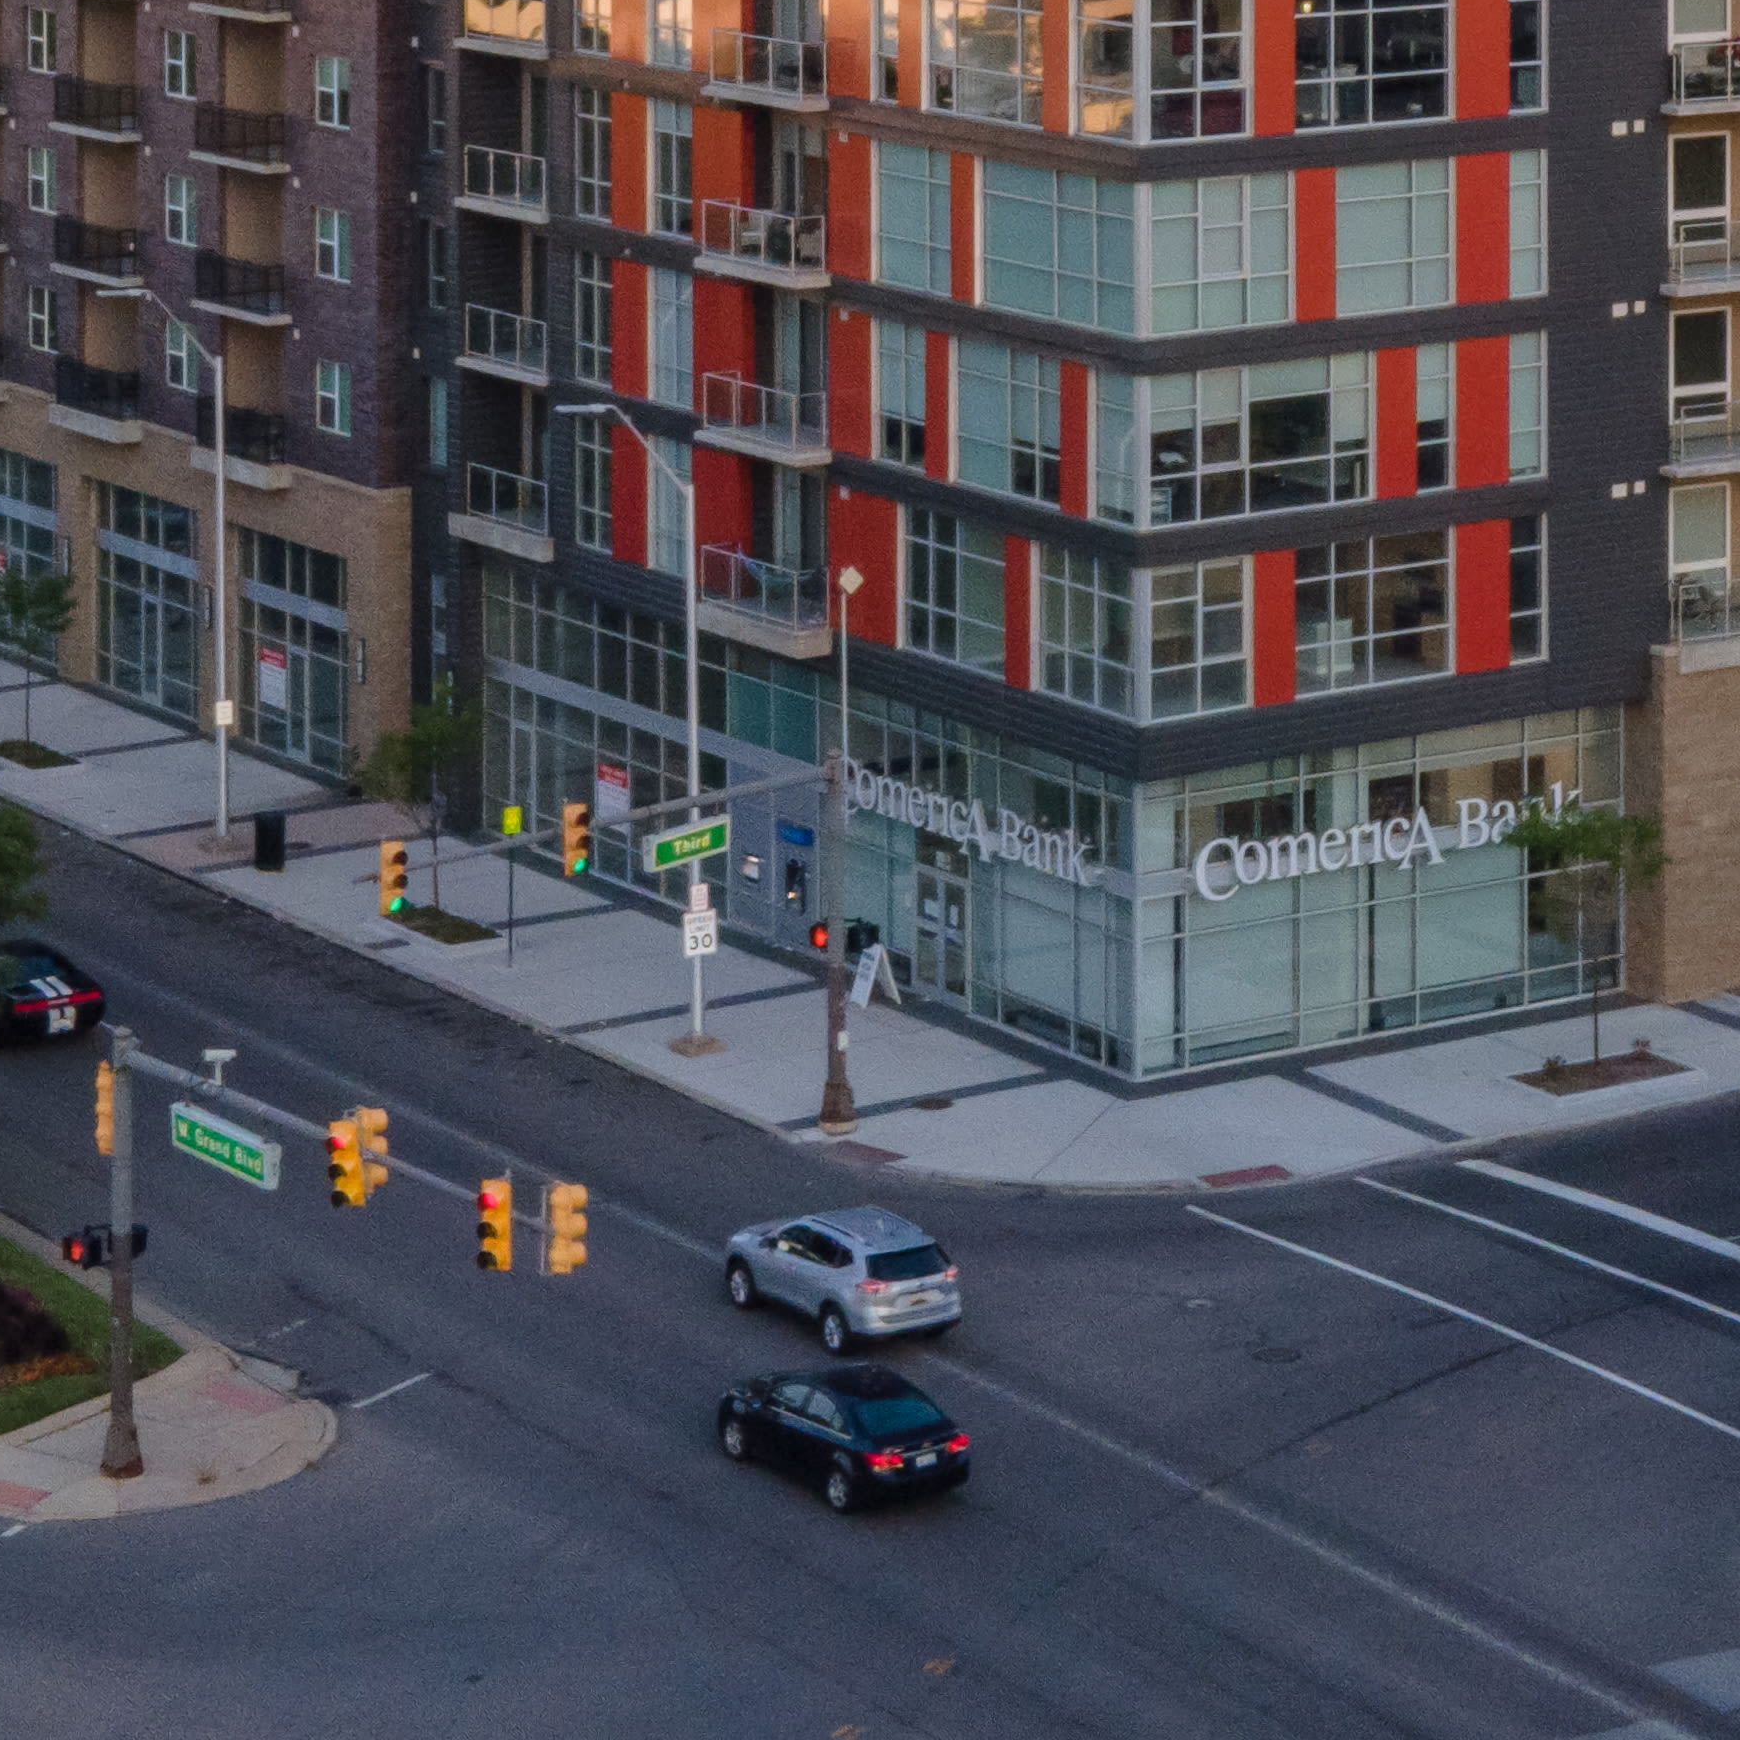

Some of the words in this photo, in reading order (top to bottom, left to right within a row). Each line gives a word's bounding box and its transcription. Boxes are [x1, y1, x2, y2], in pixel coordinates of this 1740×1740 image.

[673, 831, 711, 856] Third
[997, 807, 1094, 887] Bank
[689, 933, 713, 950] 30
[195, 1127, 231, 1159] Grand
[234, 1145, 264, 1176] Blvd
